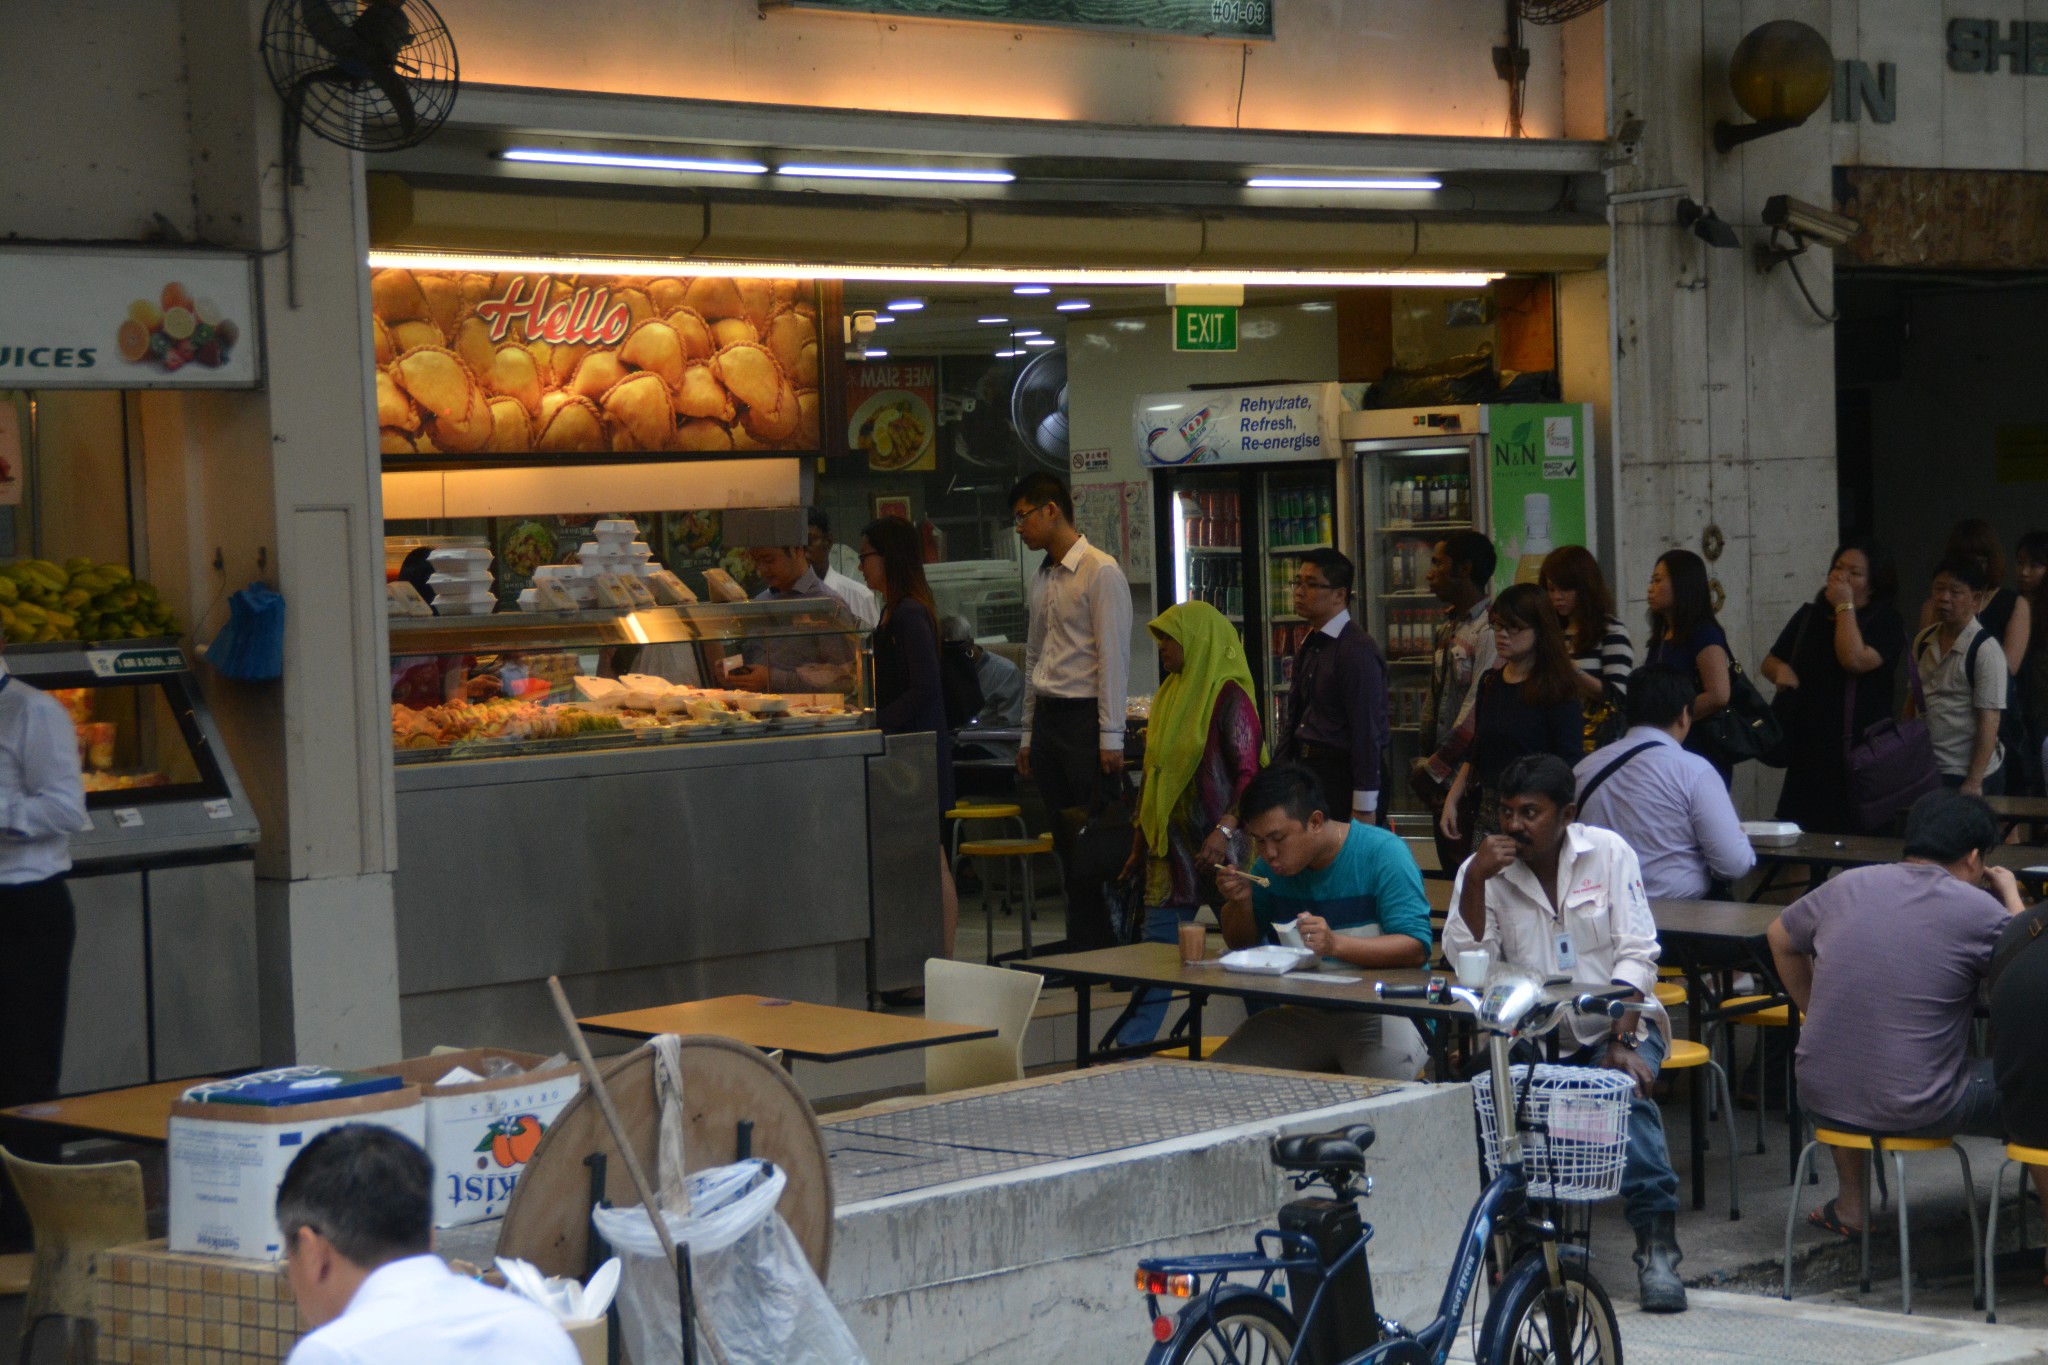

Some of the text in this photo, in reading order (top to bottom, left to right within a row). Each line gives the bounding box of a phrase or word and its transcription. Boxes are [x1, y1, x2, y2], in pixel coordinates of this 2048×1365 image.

[1212, 0, 1265, 26] #01-03
[476, 274, 630, 345] Hello
[1187, 312, 1225, 343] EXIT
[1239, 395, 1313, 414] Rehydrate,
[1240, 415, 1297, 433] Refresh,
[1241, 433, 1321, 452] Re-energise
[469, 1090, 560, 1116] ORANGES
